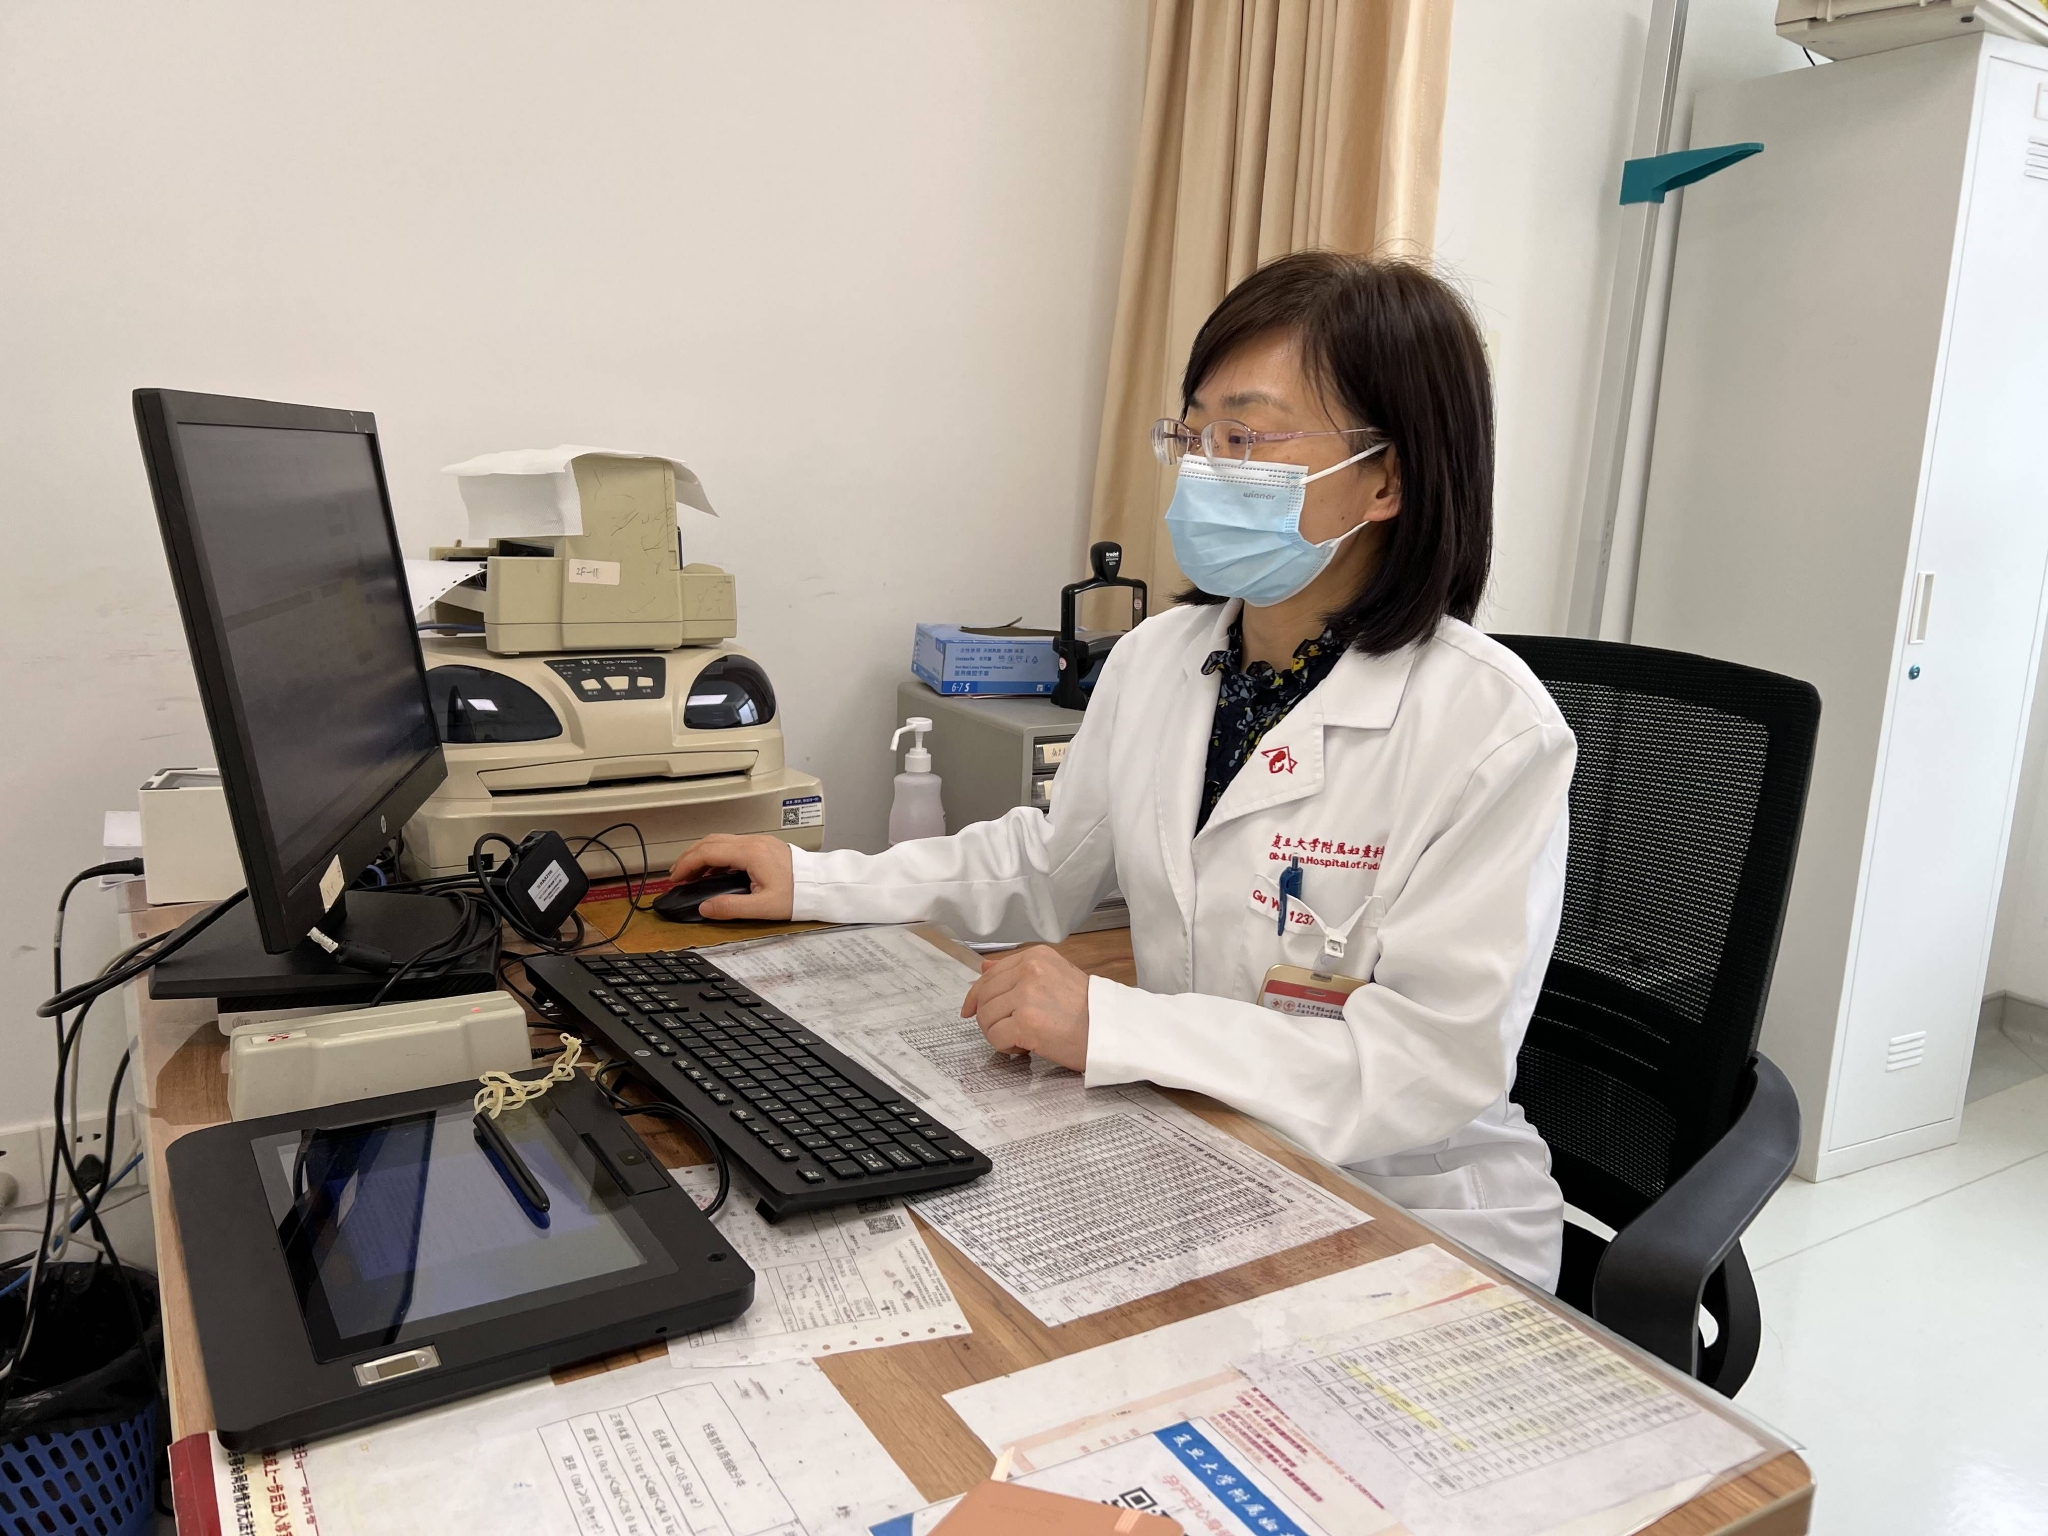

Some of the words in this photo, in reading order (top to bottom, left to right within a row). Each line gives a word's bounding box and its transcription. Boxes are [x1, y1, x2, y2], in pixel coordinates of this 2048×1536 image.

[951, 683, 963, 692] 6-7
[964, 683, 971, 692] S
[1269, 852, 1279, 860] Ob
[1306, 856, 1349, 869] Hospital
[1351, 860, 1361, 869] of
